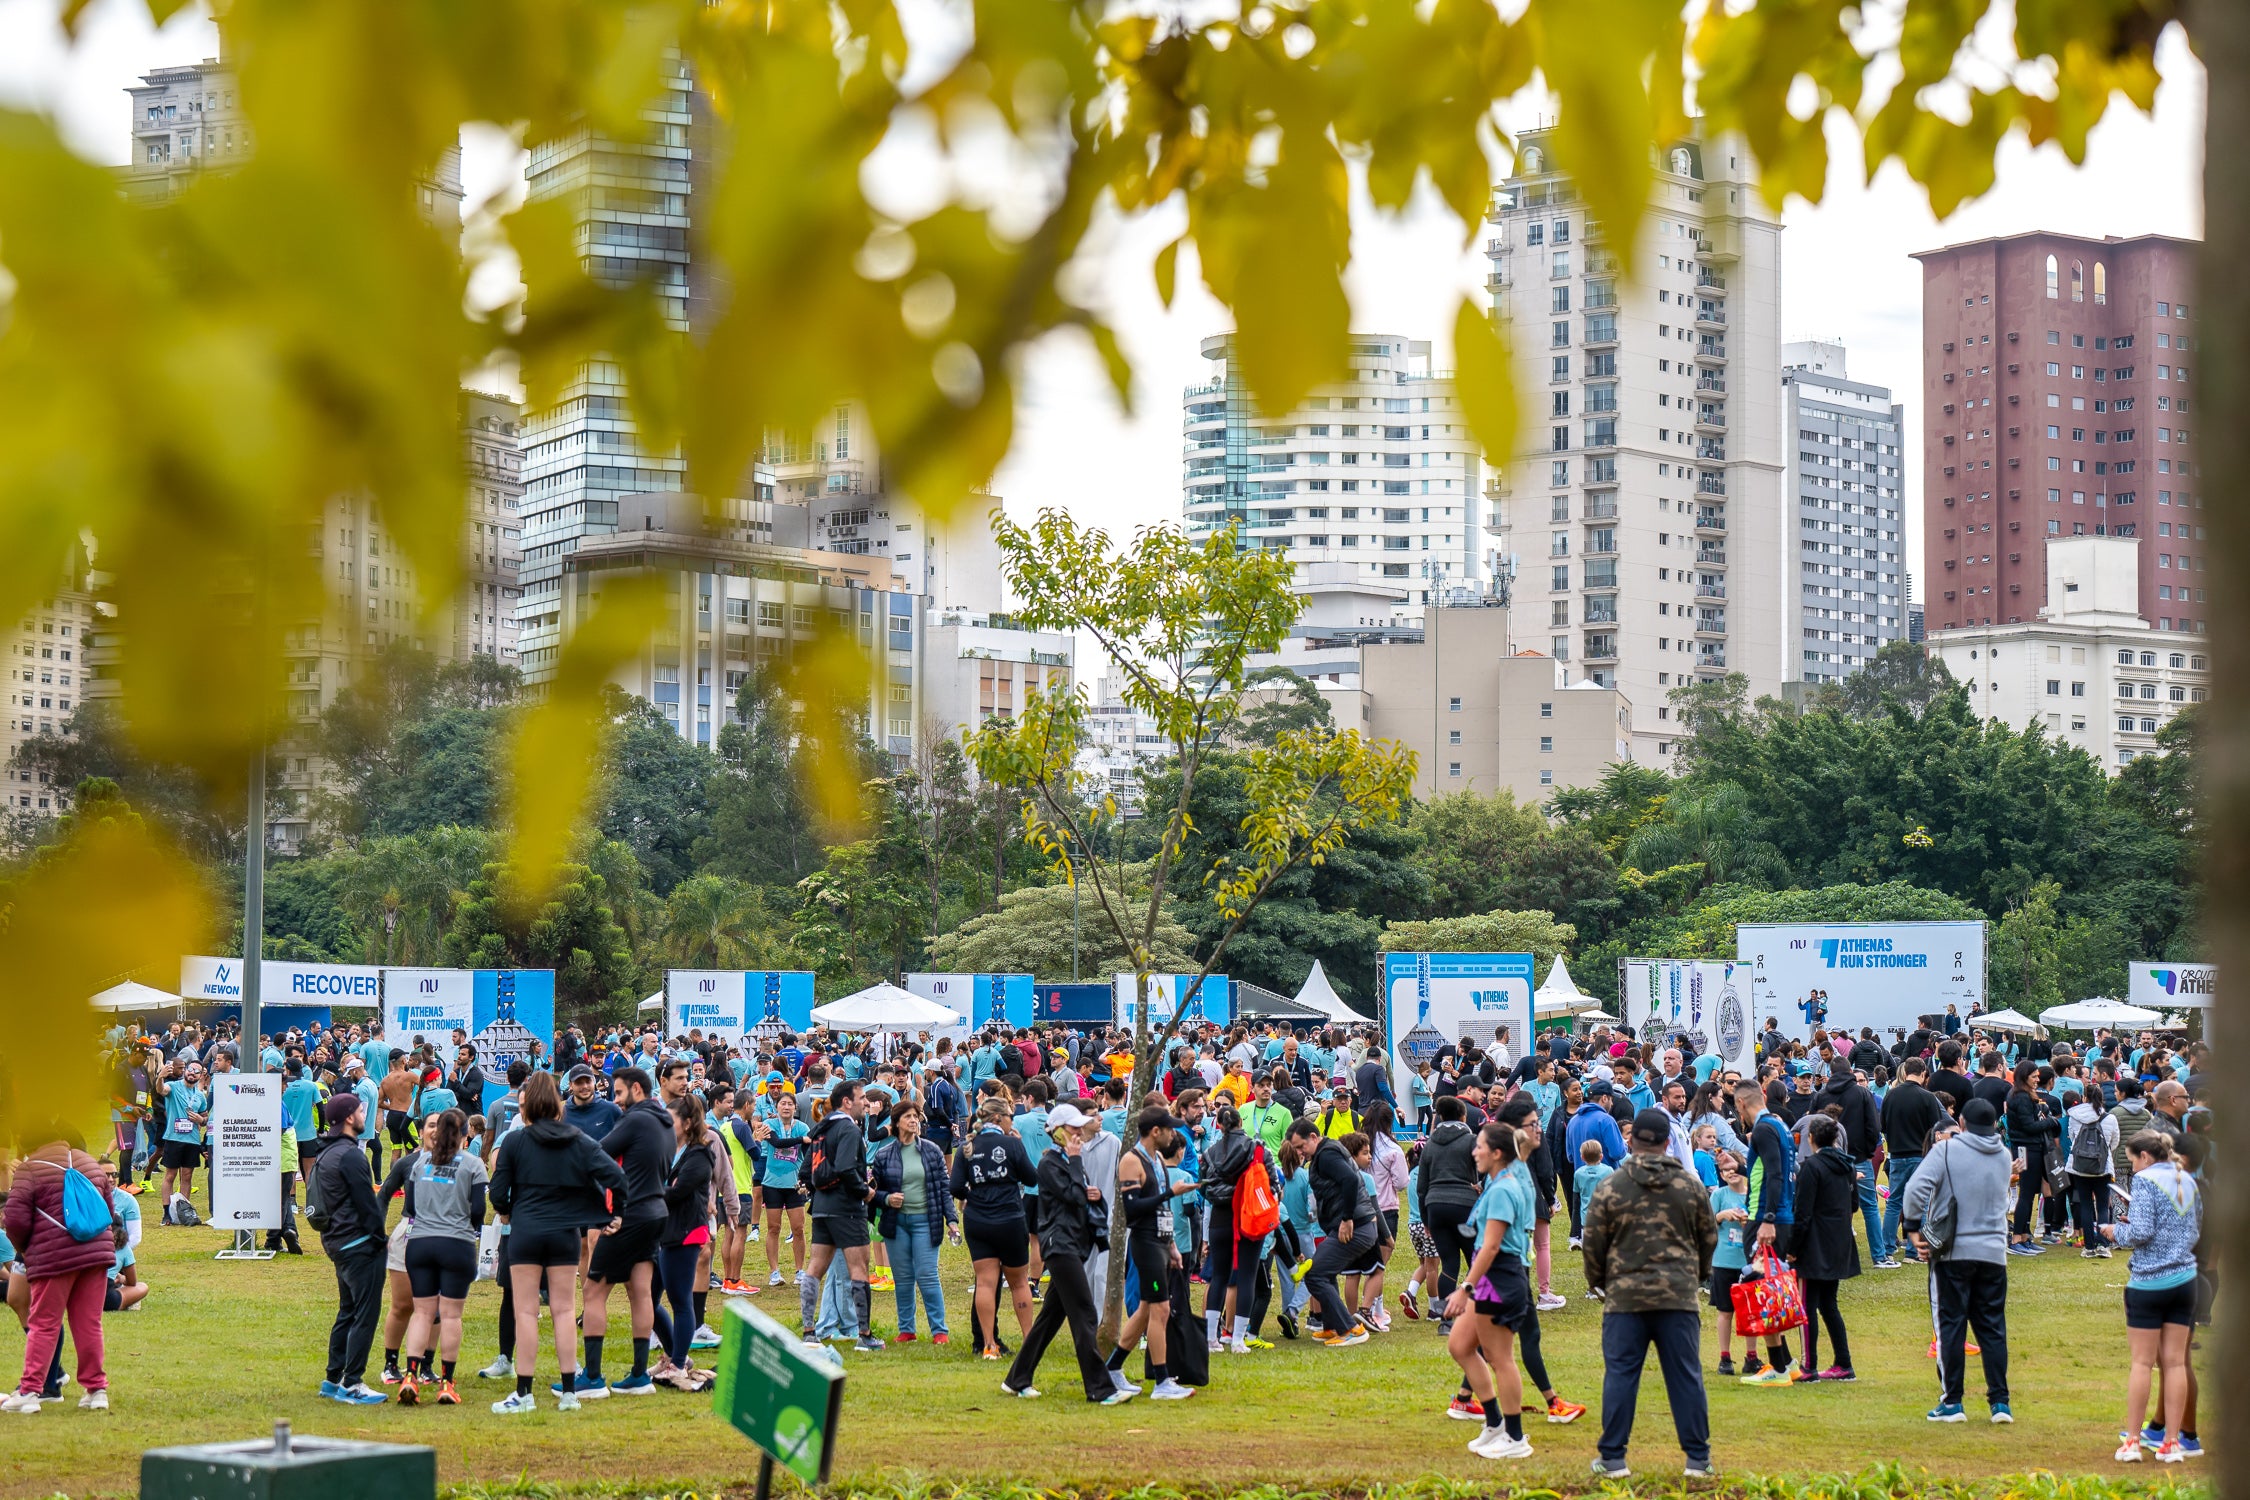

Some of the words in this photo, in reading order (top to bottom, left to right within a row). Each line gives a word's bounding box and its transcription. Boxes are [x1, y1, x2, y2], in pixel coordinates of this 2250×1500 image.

[1840, 938, 1893, 952] ATHENAS
[1840, 954, 1864, 968] RUN
[1865, 954, 1927, 968] STRONGER
[204, 984, 239, 995] NEWON
[293, 974, 378, 996] RECOVER
[2180, 980, 2215, 994] ATHE
[1483, 991, 1508, 1002] ATHENAS
[410, 1006, 444, 1017] ATHENAS
[691, 1005, 719, 1014] ATHENAS
[410, 1020, 425, 1030] RUN
[426, 1019, 464, 1030] STRONGER
[691, 1017, 704, 1027] RUN
[705, 1017, 737, 1027] STRONGER
[1420, 1040, 1439, 1050] ATHENAS
[434, 1166, 458, 1178] 25K
